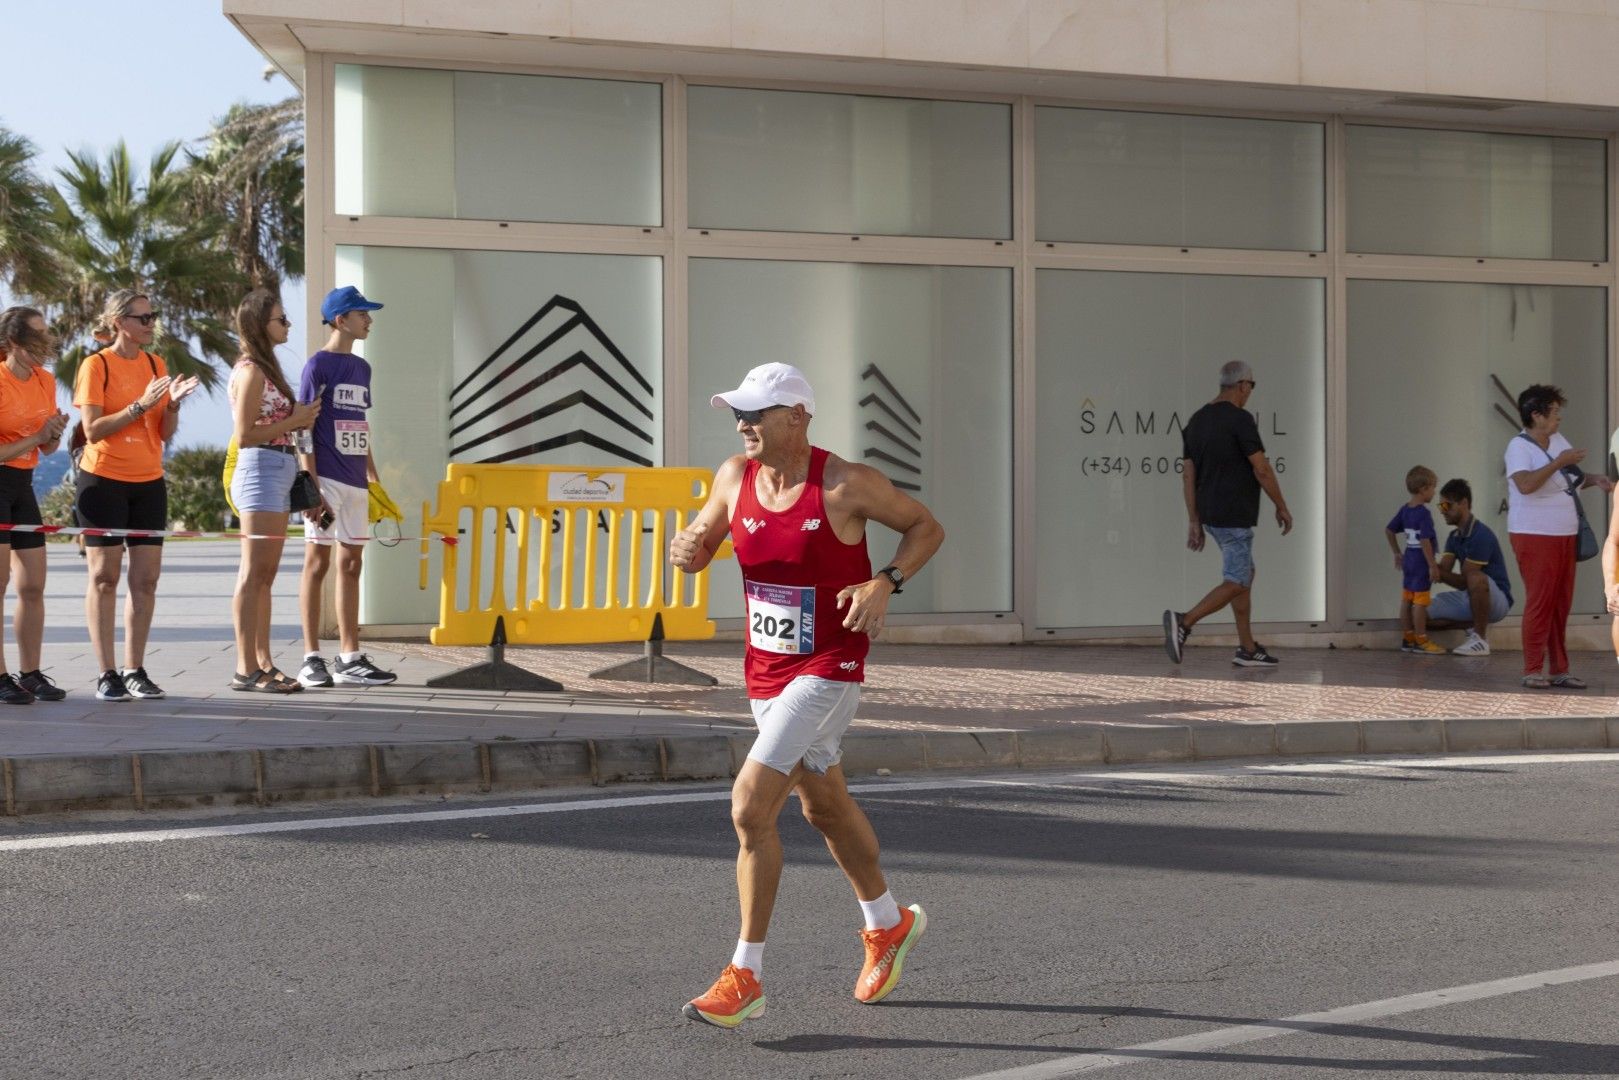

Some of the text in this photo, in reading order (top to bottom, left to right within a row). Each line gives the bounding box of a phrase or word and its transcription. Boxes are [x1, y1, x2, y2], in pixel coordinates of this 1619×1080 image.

[338, 389, 354, 401] TM
[341, 432, 368, 449] 515
[1081, 457, 1185, 476] (+34) 606
[752, 611, 795, 640] 202
[801, 612, 813, 644] 7 KM
[865, 943, 898, 987] KIPRUN
